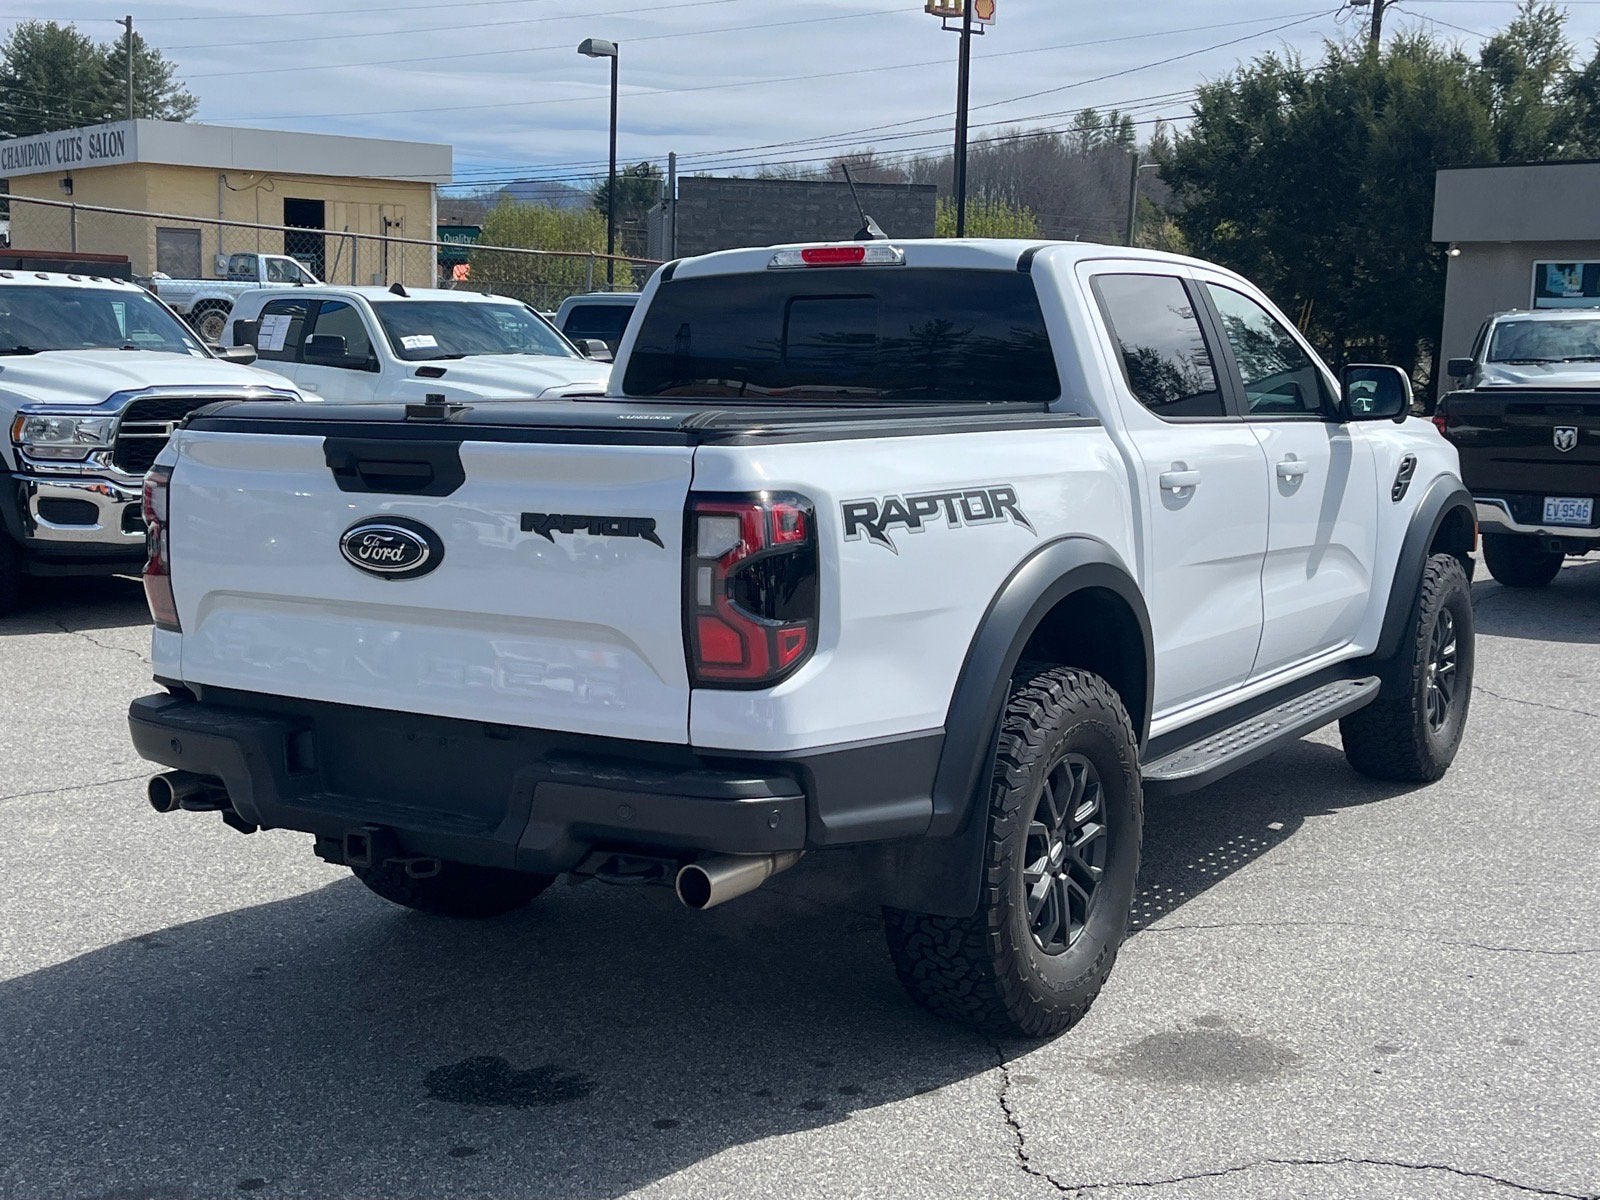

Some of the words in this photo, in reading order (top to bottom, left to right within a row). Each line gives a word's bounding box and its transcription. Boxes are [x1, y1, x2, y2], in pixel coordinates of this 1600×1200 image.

[1, 141, 51, 170] CHAMPION
[55, 136, 82, 164] CUTS
[89, 130, 125, 160] SALON
[443, 233, 472, 245] Quality
[520, 512, 664, 549] RAPTOR
[840, 485, 1037, 555] RAPTOR
[359, 534, 405, 561] Ford
